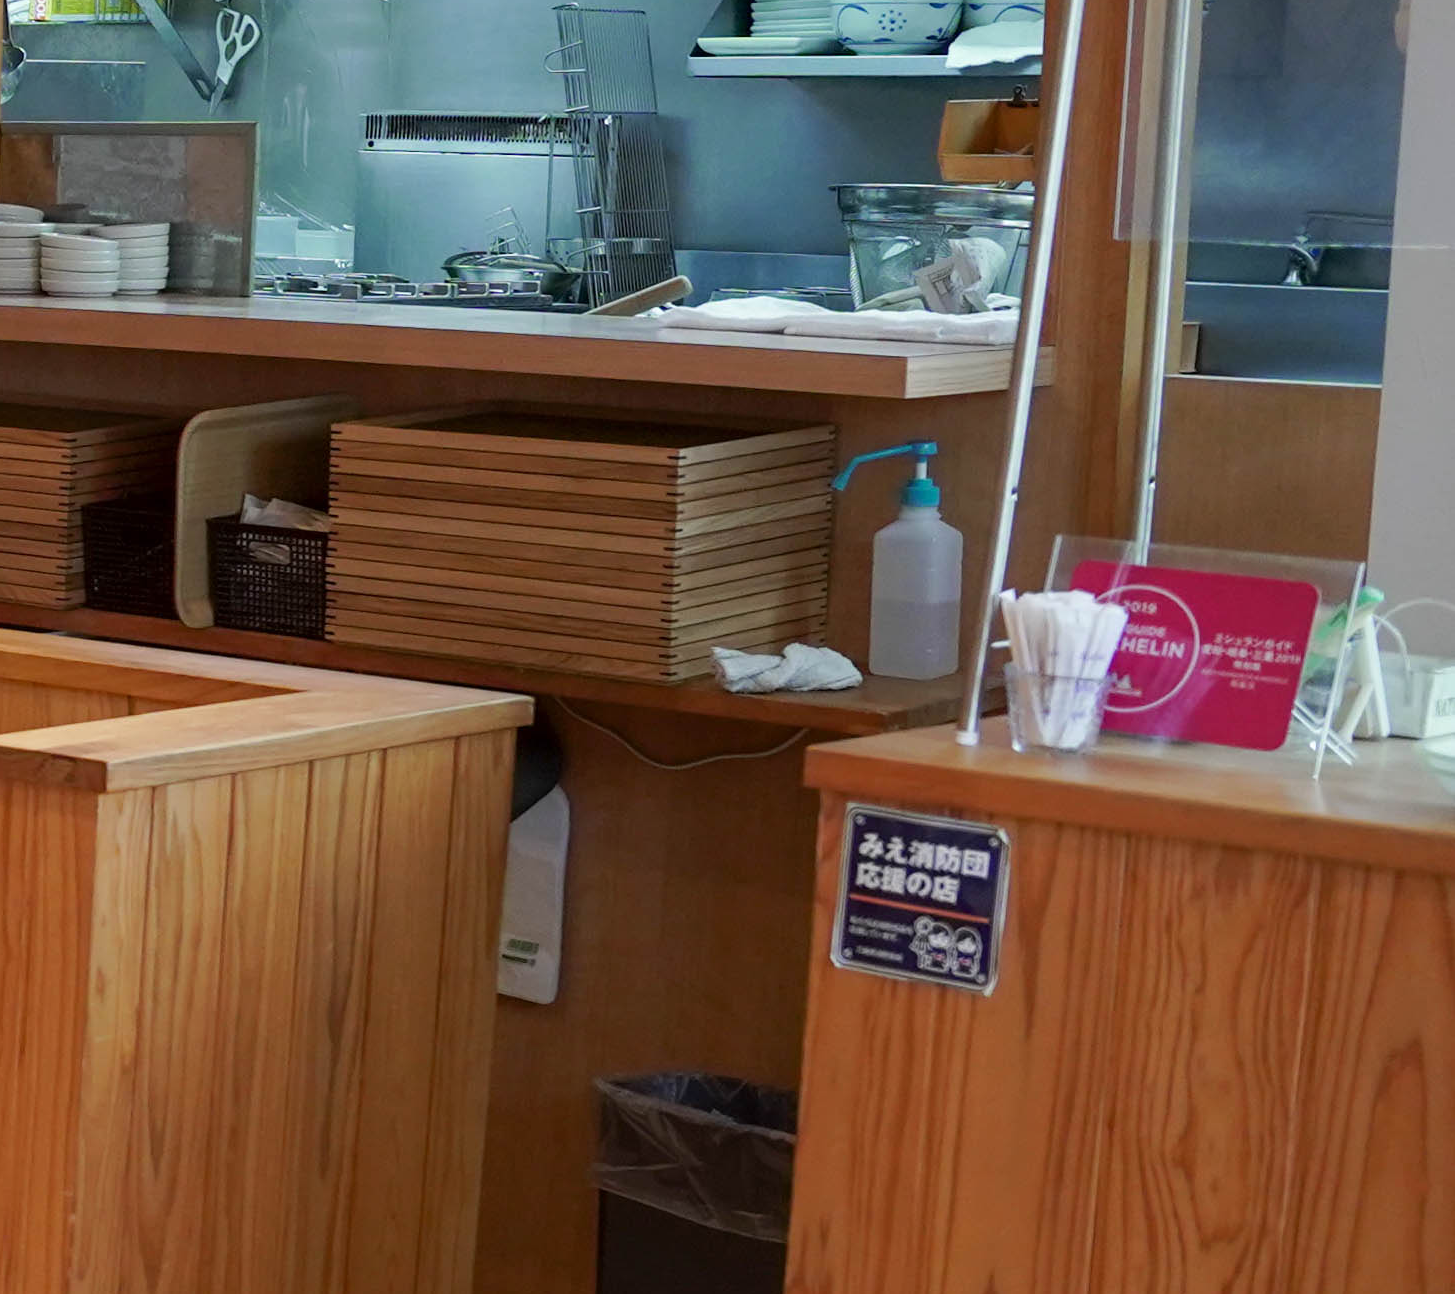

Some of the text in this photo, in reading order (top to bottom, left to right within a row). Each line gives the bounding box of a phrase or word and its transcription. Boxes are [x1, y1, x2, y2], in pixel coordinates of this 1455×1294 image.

[1120, 638, 1186, 659] HELIN
[858, 832, 990, 879] みえ消防団
[855, 862, 961, 905] 応援の店
